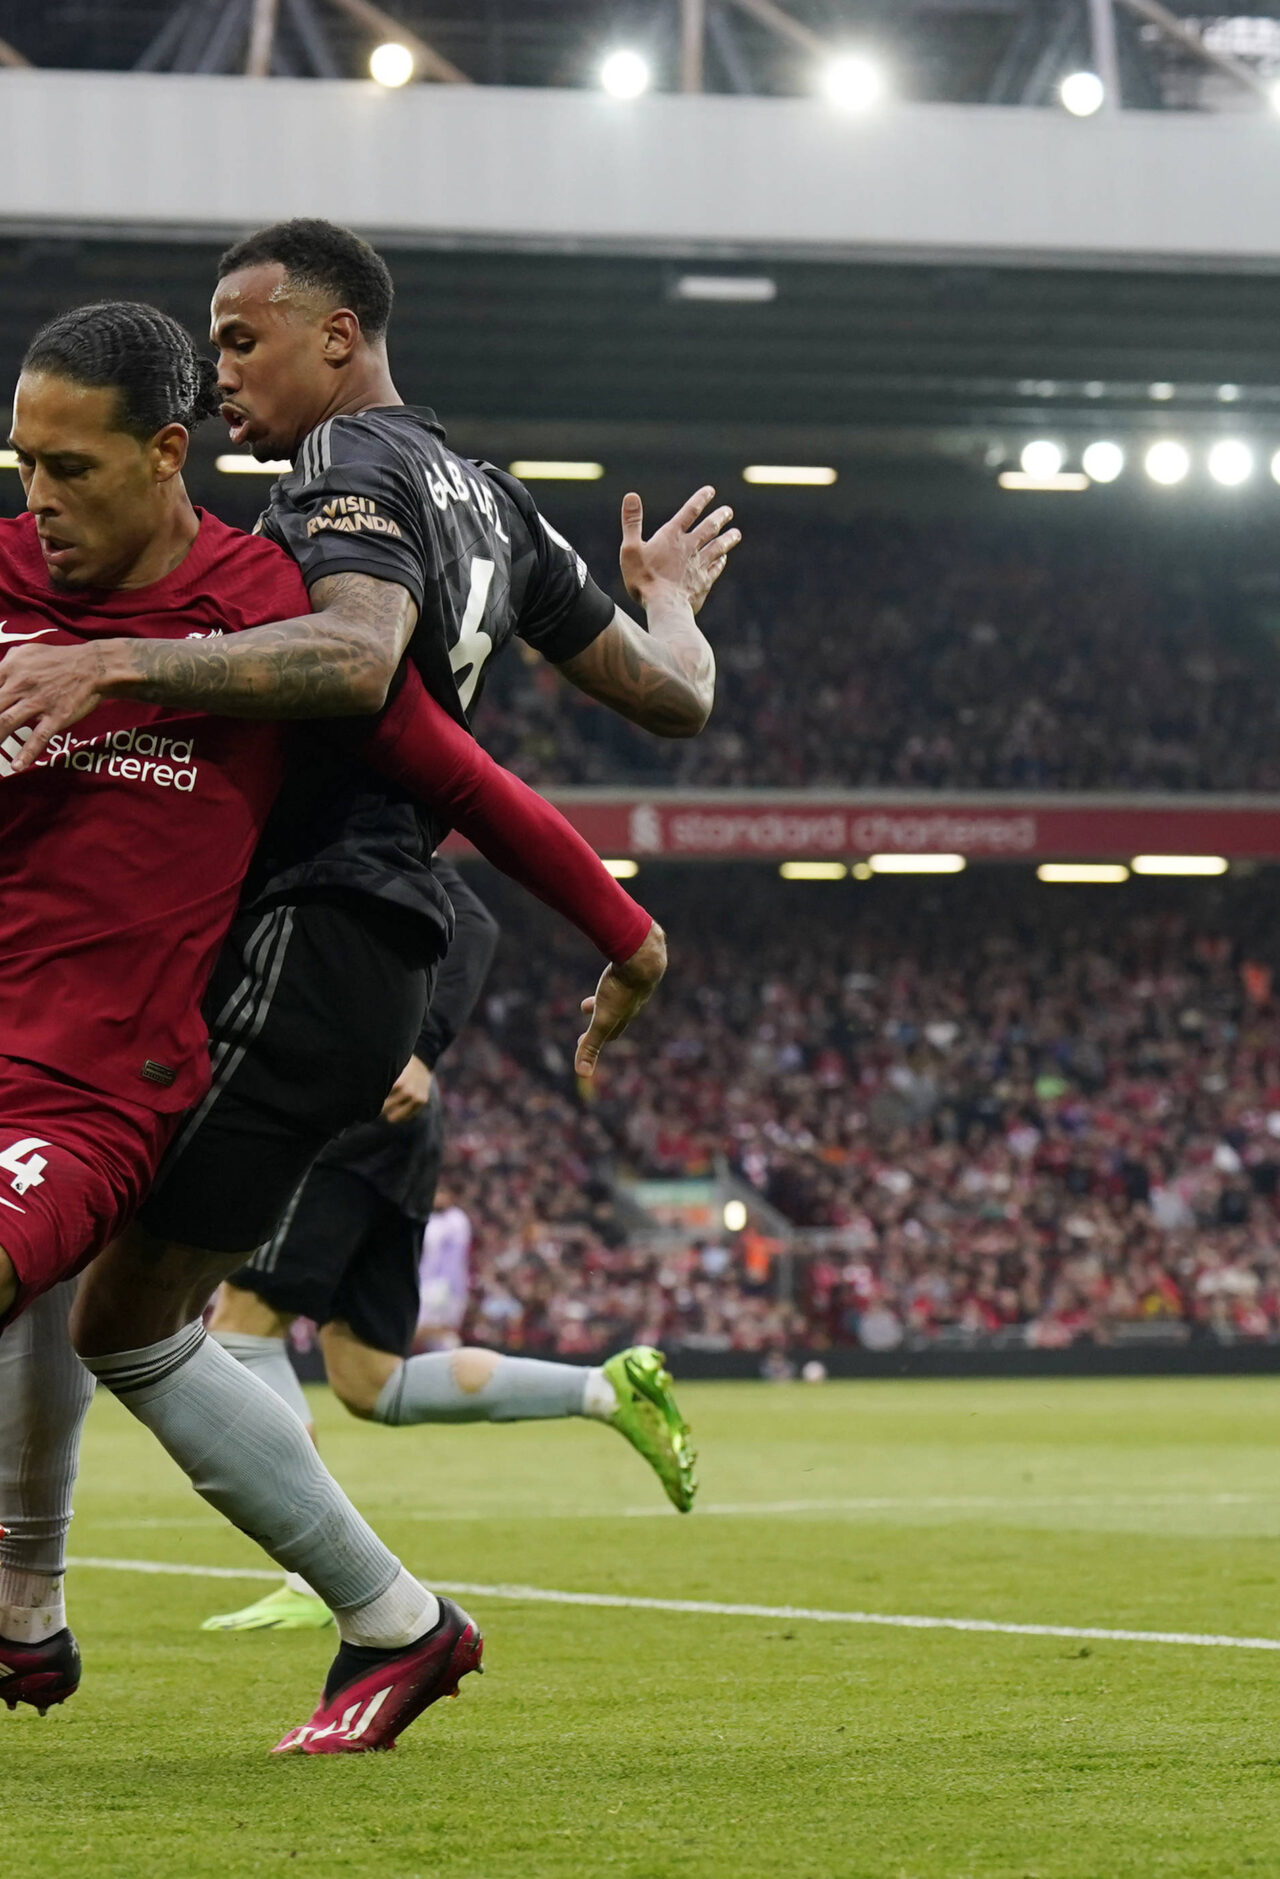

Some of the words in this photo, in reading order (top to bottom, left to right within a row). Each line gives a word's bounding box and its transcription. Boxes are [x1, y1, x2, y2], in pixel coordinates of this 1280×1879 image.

[322, 495, 375, 518] VISIT
[424, 460, 509, 544] GABIEL
[306, 512, 402, 538] RWANDA
[46, 727, 194, 764] stndard
[670, 812, 847, 852] standard
[852, 812, 1037, 852] chartered
